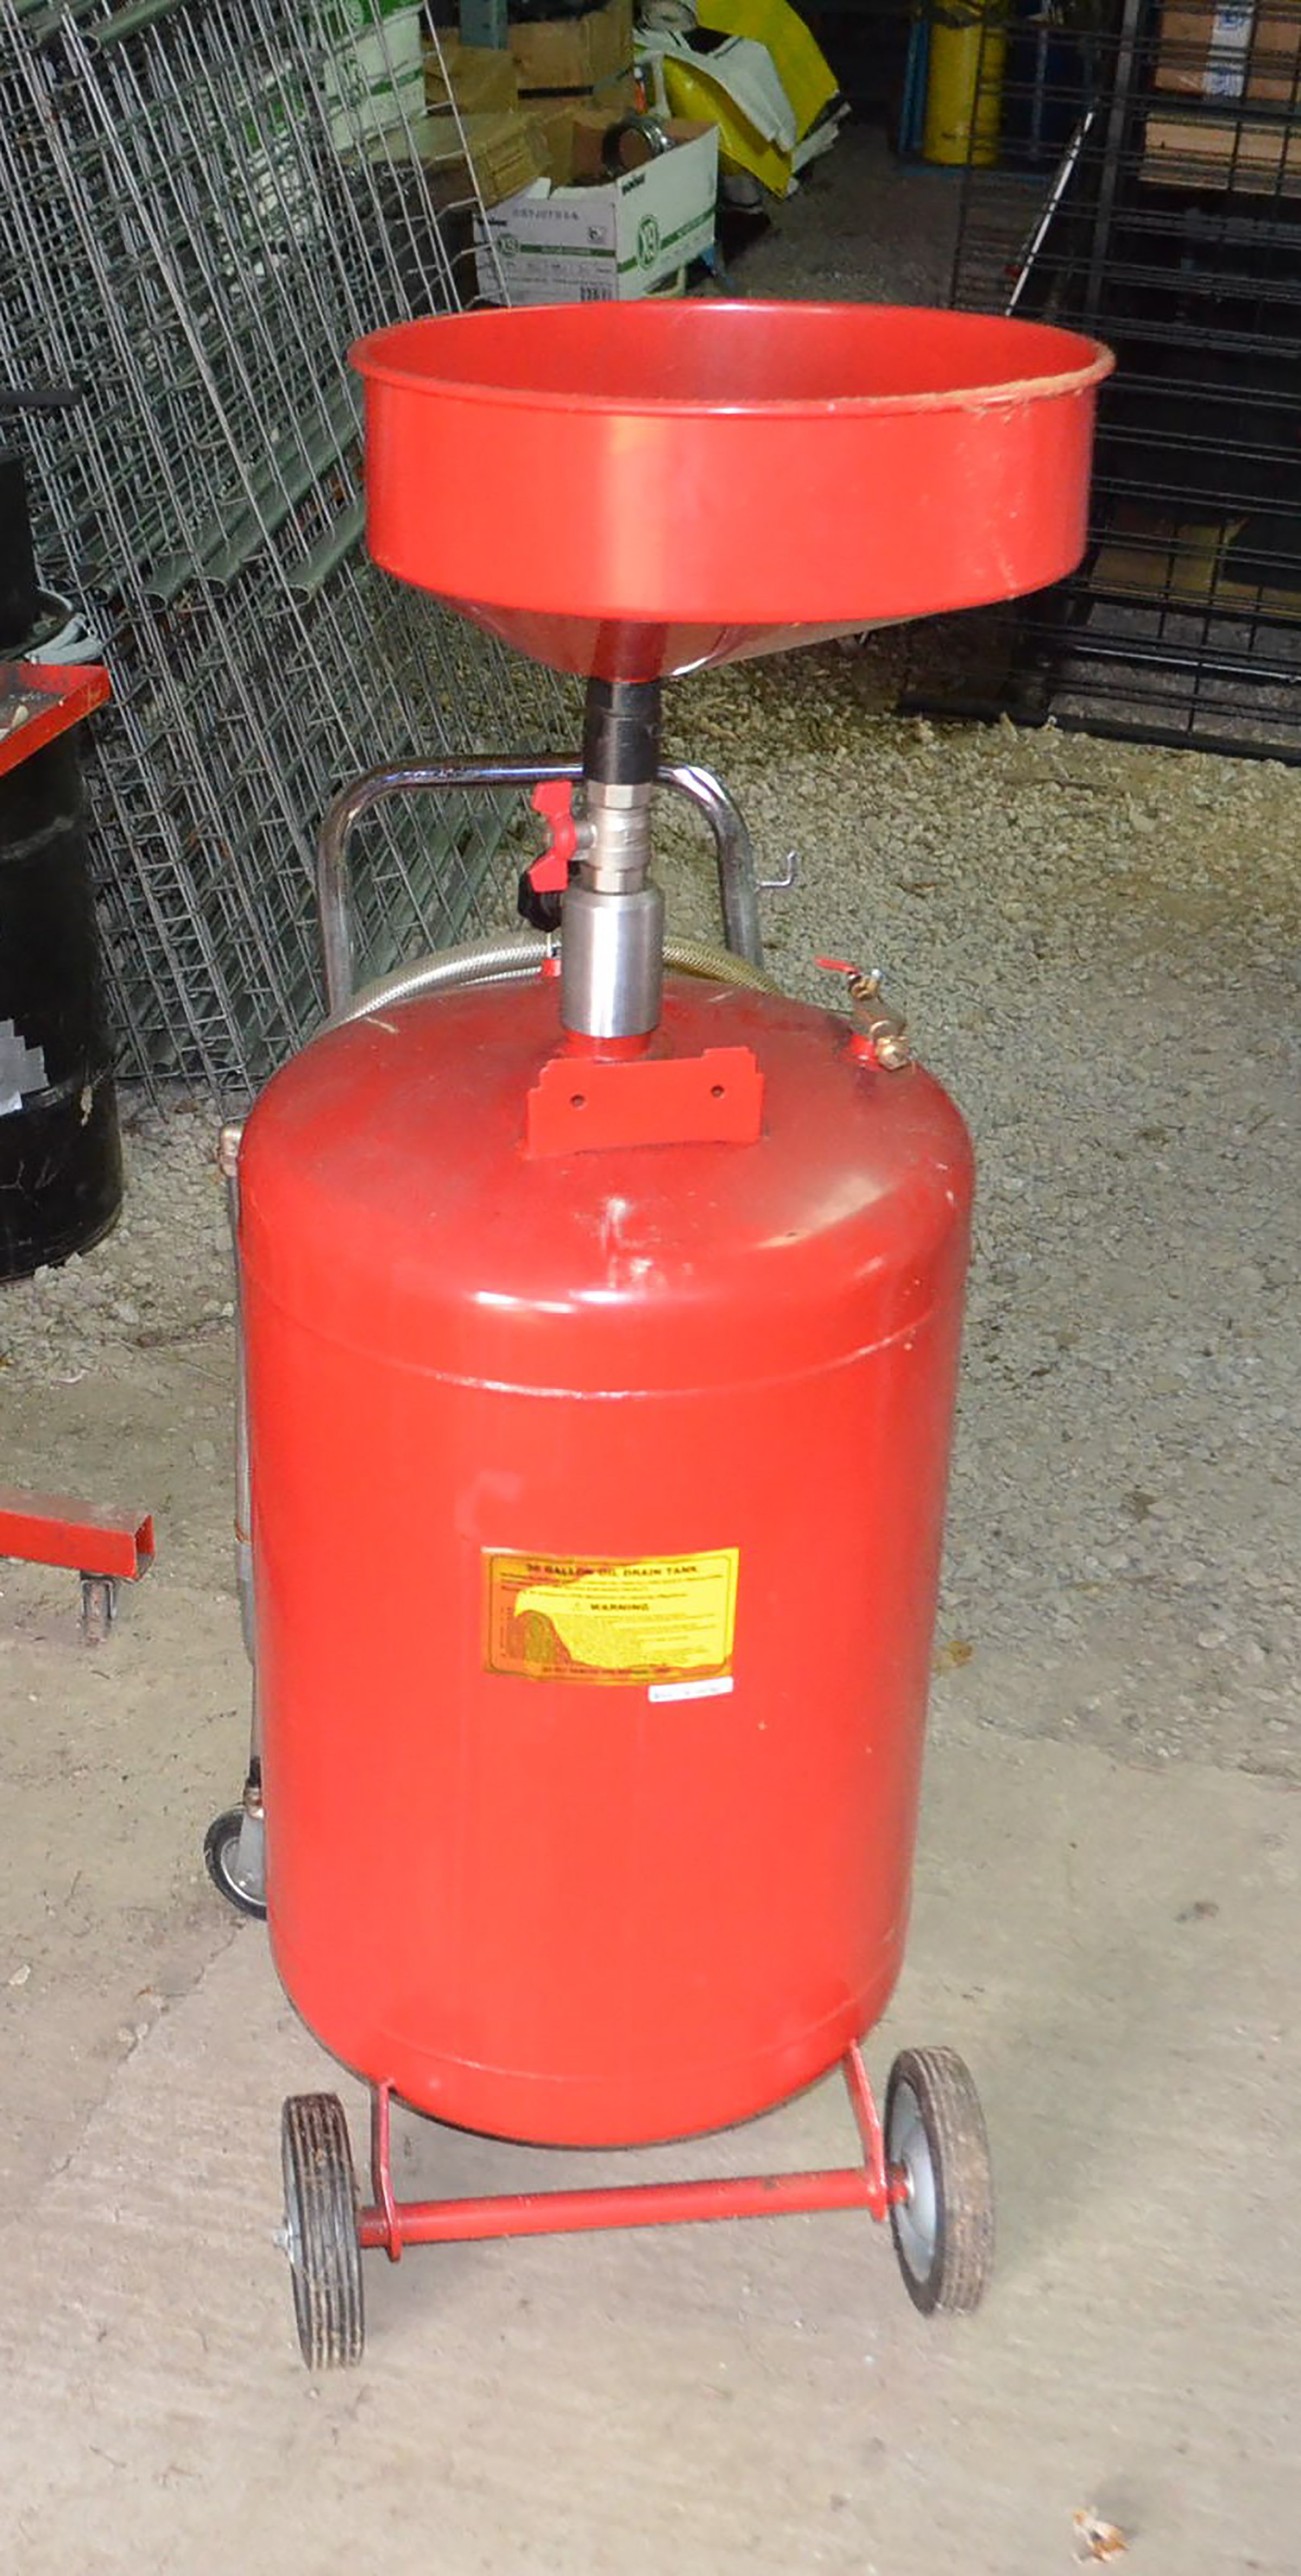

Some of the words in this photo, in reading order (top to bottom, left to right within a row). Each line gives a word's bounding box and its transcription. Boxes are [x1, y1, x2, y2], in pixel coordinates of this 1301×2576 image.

[544, 1565, 594, 1576] GALLON
[598, 1568, 617, 1577] OIL
[623, 1568, 662, 1577] DRAIN
[667, 1565, 697, 1576] TANK
[590, 1603, 649, 1611] WARNING
